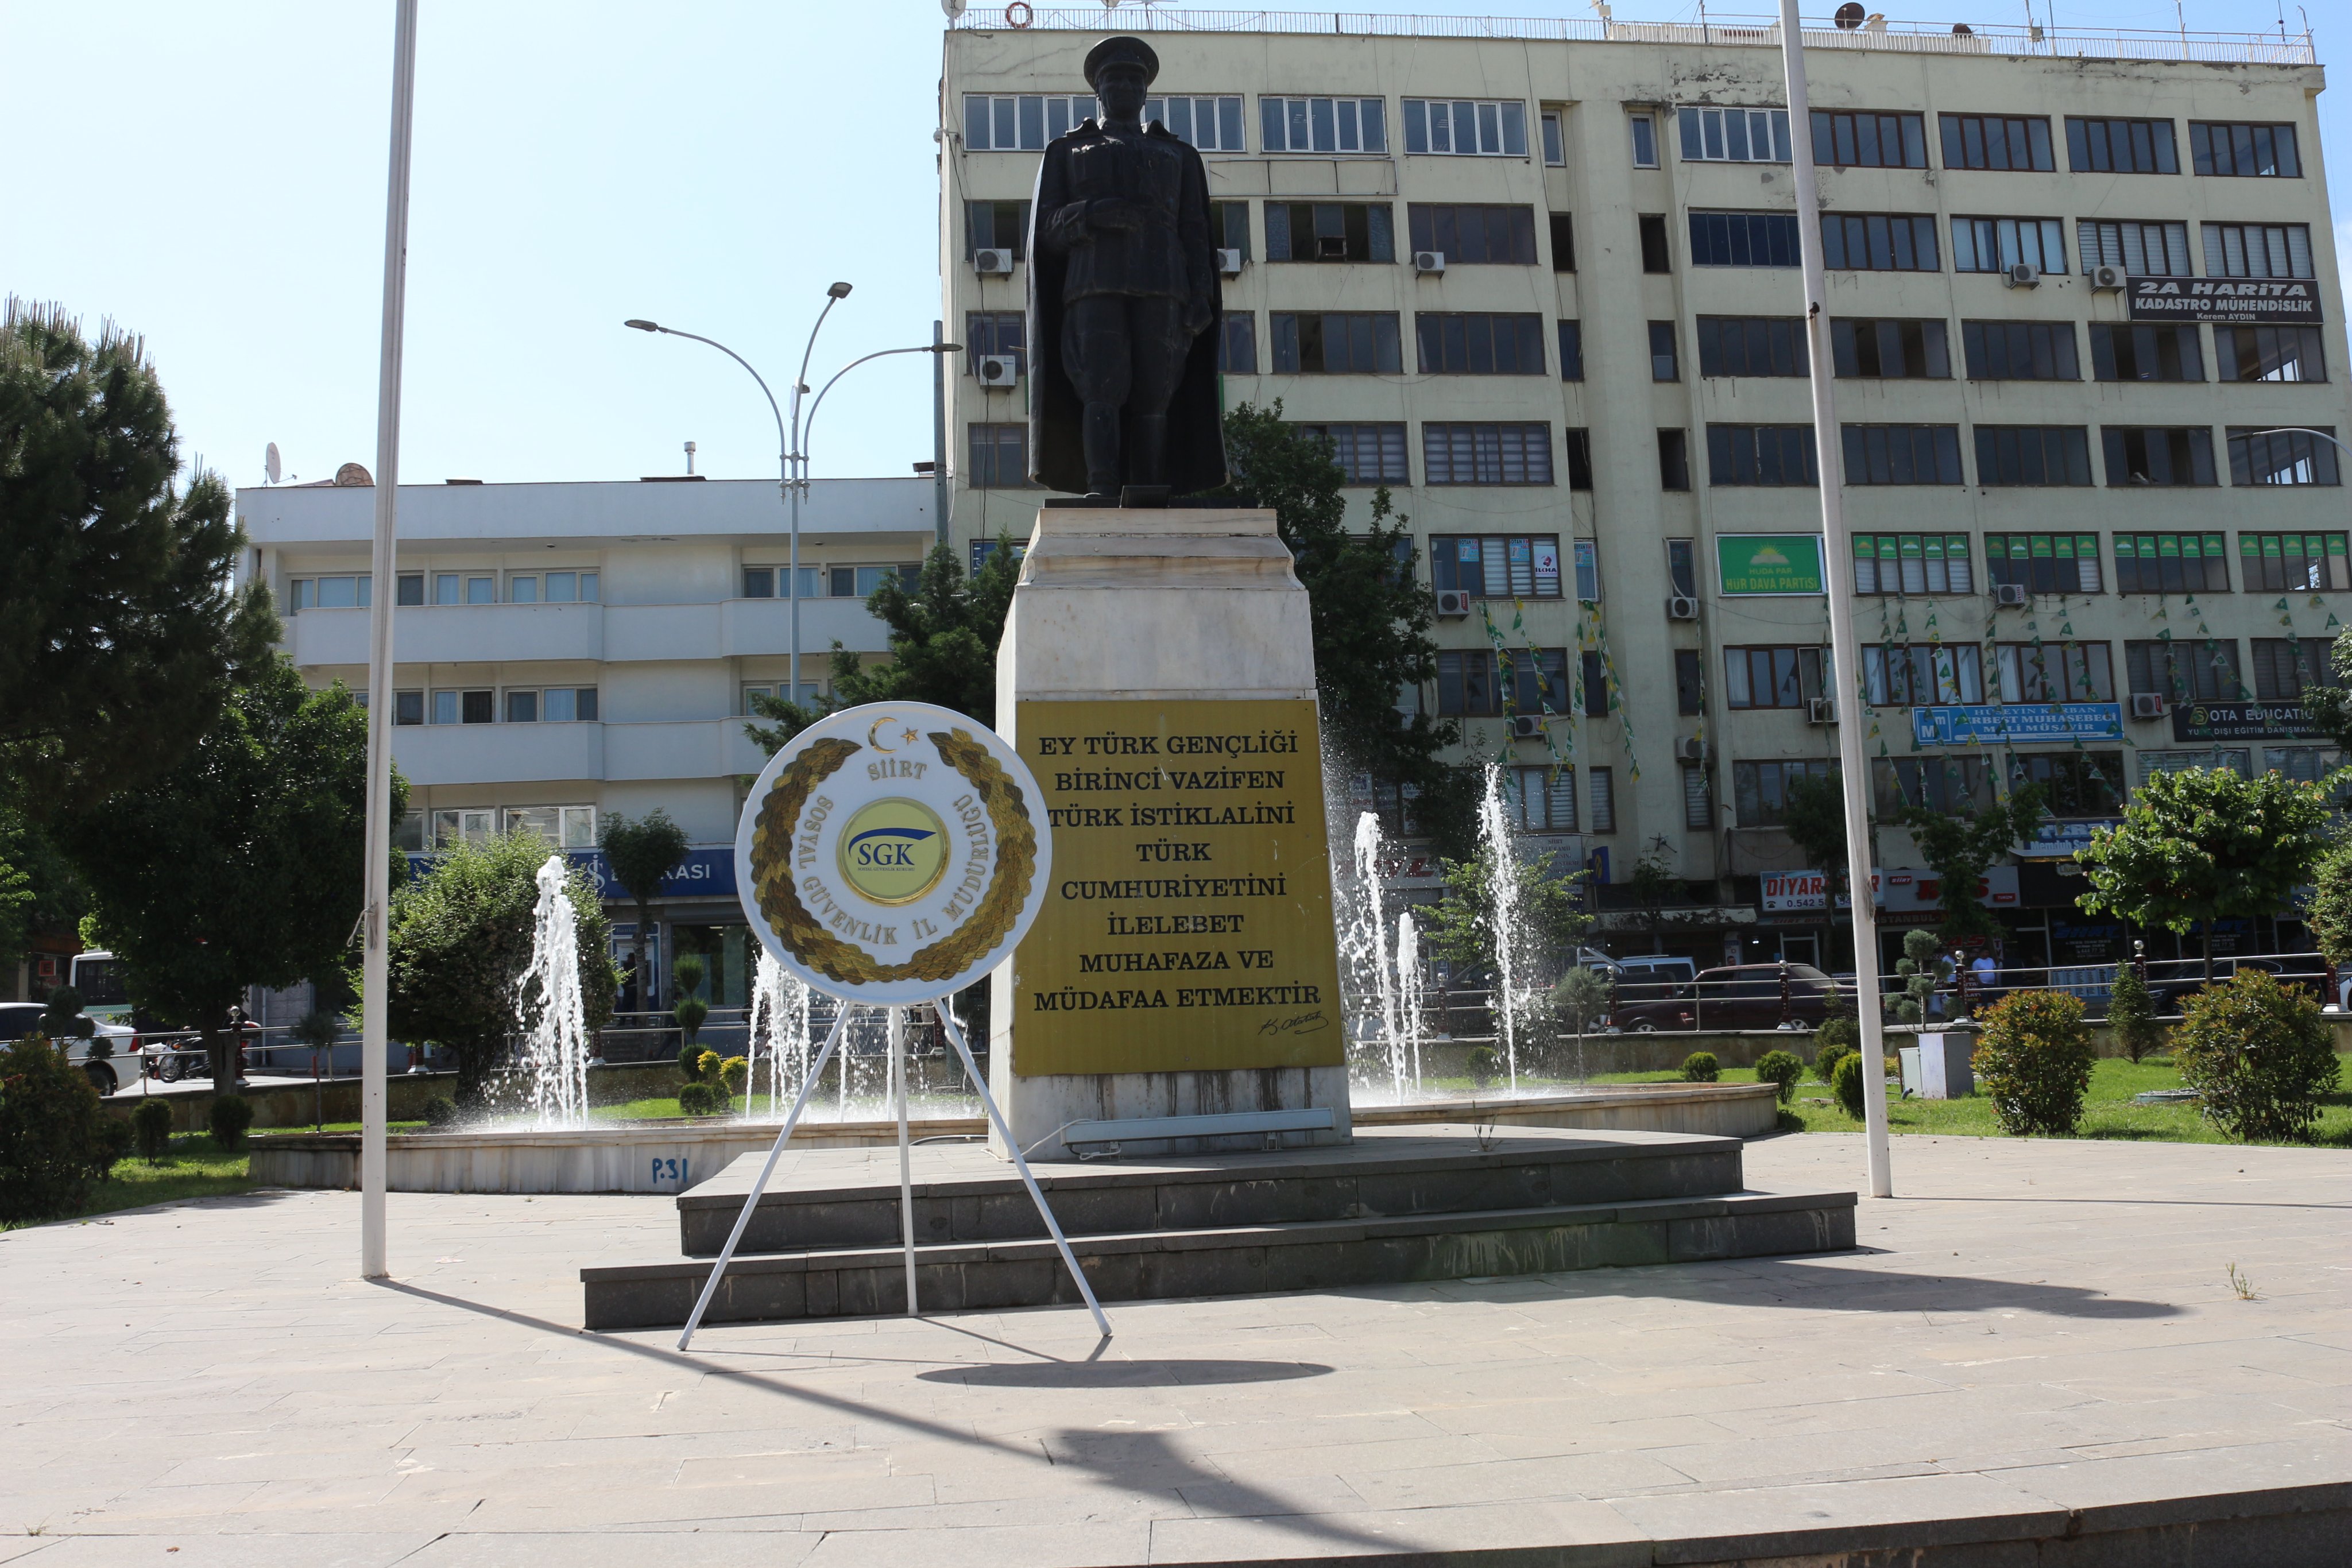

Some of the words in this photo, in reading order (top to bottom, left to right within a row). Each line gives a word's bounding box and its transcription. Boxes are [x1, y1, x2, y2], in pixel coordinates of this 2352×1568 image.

[2138, 282, 2180, 294] 2A
[2135, 298, 2211, 311] KADASTRO
[1751, 578, 1777, 590] DAVA
[1039, 737, 1077, 756] EY
[1084, 731, 1160, 755] TÜRK
[1166, 730, 1298, 758] GENÇLİĞİ
[868, 757, 927, 781] SİİRT
[1055, 766, 1162, 791] BİRİNCİ
[1168, 765, 1285, 789] VAZİFEN
[1047, 803, 1123, 827] TÜRK
[1130, 800, 1295, 826] İSTİKLALİNİ
[799, 795, 833, 869] SOSYAL
[857, 843, 915, 865] SGK
[942, 794, 989, 922] MÜDÜRLÜĞÜ
[1136, 838, 1212, 862] TÜRK
[1061, 872, 1287, 900] CUMHURİYETİNİ
[803, 876, 898, 944] GÜVENLİK
[911, 918, 938, 940] İL
[1107, 911, 1244, 936] İLELEBET
[1079, 951, 1231, 973] MUHAFAZA
[1237, 950, 1274, 969] VE
[1034, 986, 1169, 1012] MÜDAFAA
[1176, 980, 1321, 1008] ETMEKTİR
